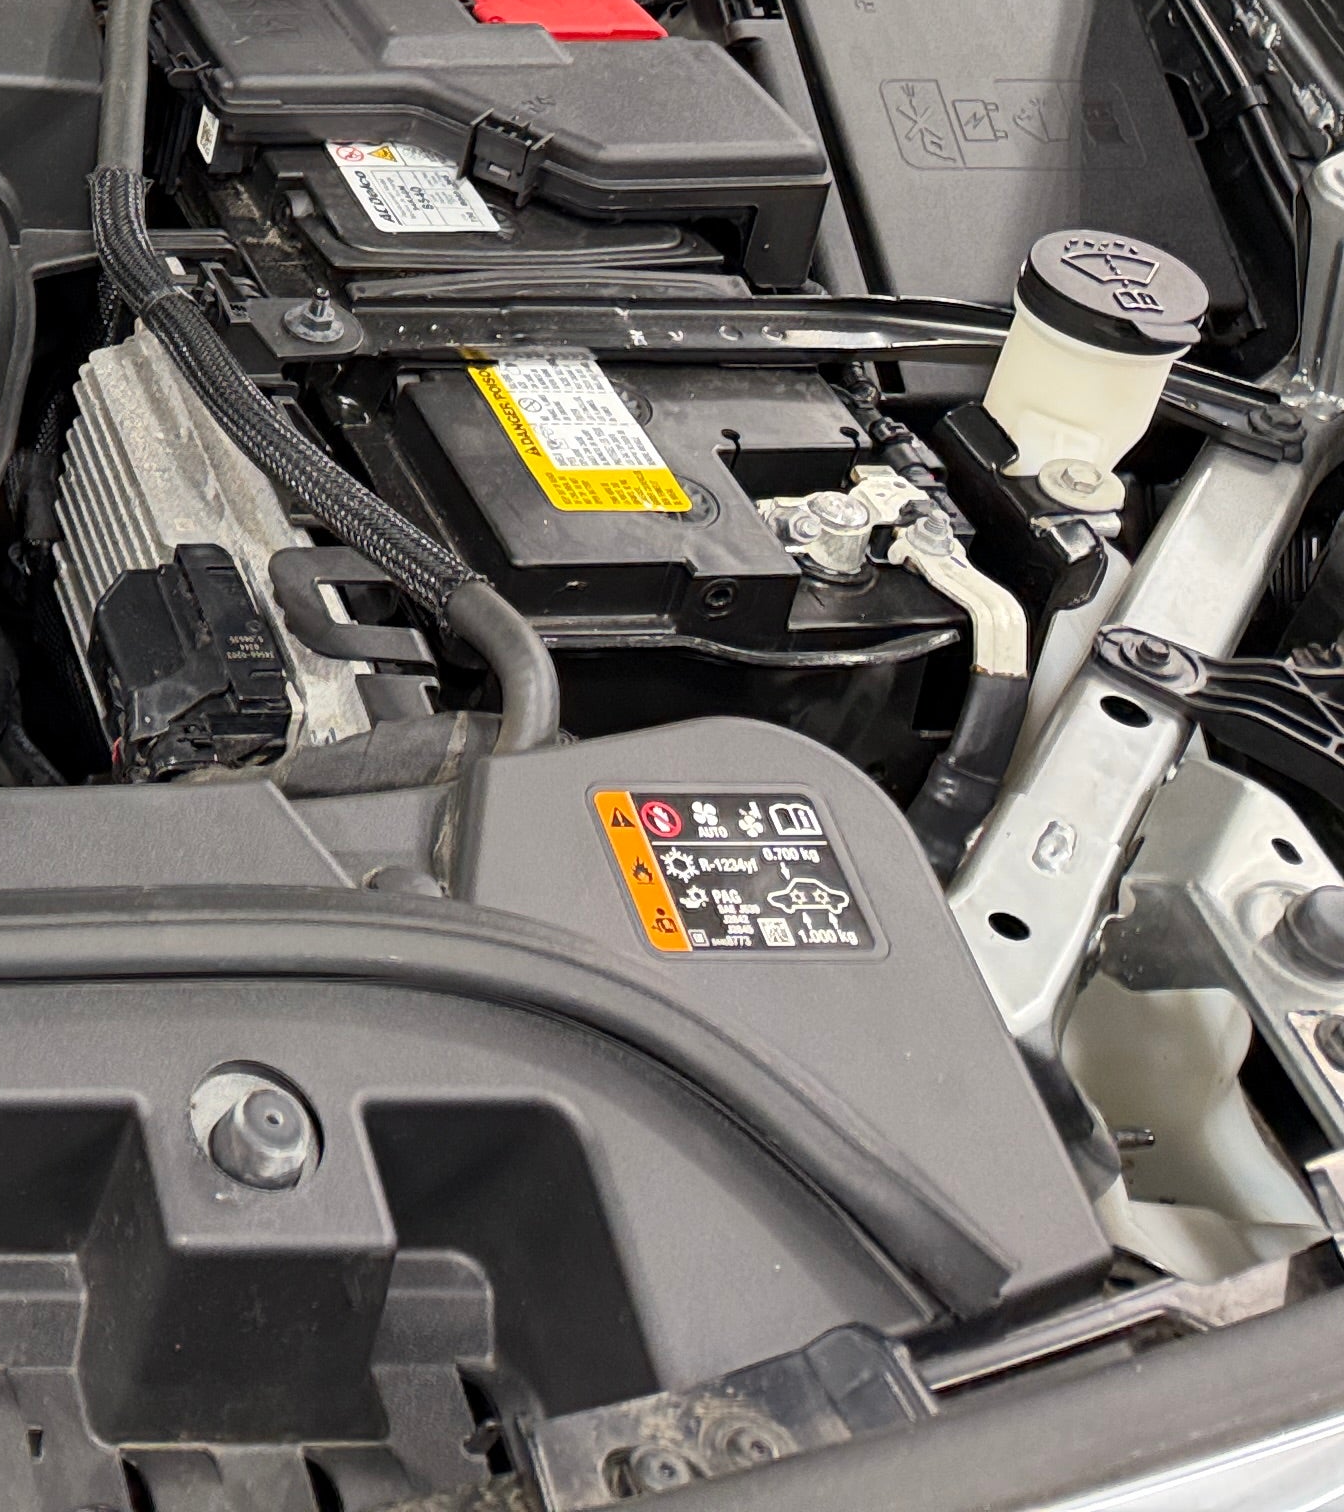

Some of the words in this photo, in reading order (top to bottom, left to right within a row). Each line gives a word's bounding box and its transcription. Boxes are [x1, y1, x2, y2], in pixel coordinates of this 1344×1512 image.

[499, 402, 534, 446] DANGER
[697, 826, 729, 838] AUTO
[762, 847, 799, 861] 0.700
[799, 847, 820, 863] kg
[698, 857, 759, 875] R-1234yf
[711, 889, 742, 904] PAG
[797, 928, 836, 945] 1.000
[837, 929, 859, 946] kg
